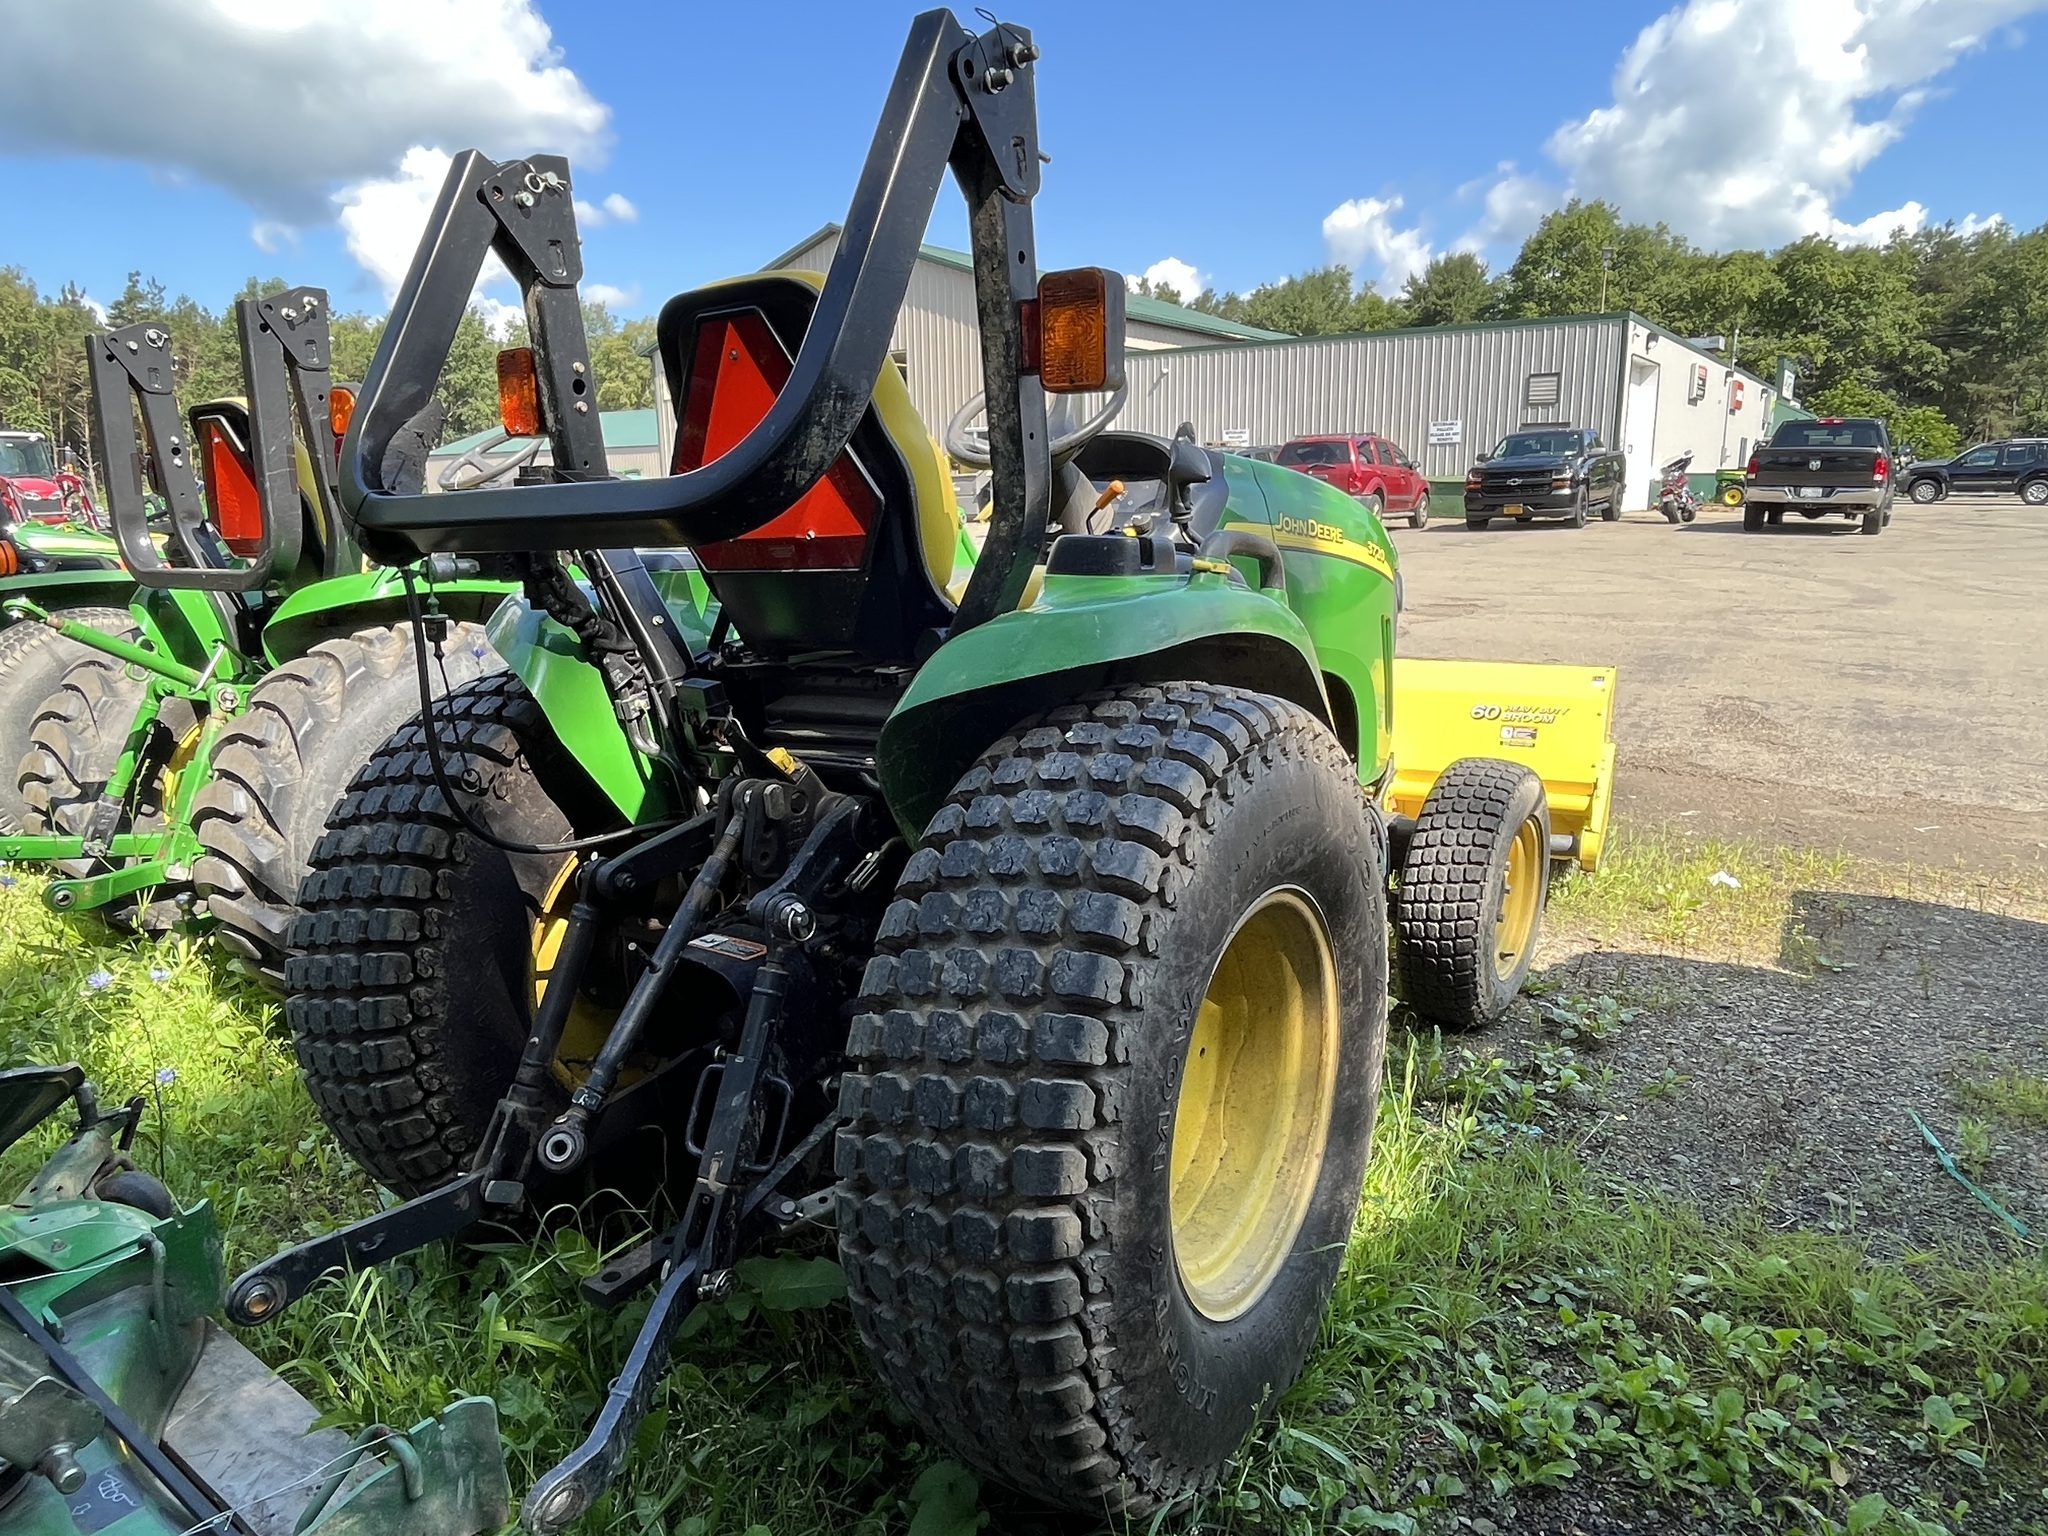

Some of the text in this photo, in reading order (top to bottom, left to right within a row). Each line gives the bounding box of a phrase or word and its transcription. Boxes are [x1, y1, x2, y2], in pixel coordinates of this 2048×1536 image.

[1275, 513, 1343, 543] JOHN DEERE
[1470, 704, 1502, 721] 60
[1501, 713, 1556, 725] BROOM
